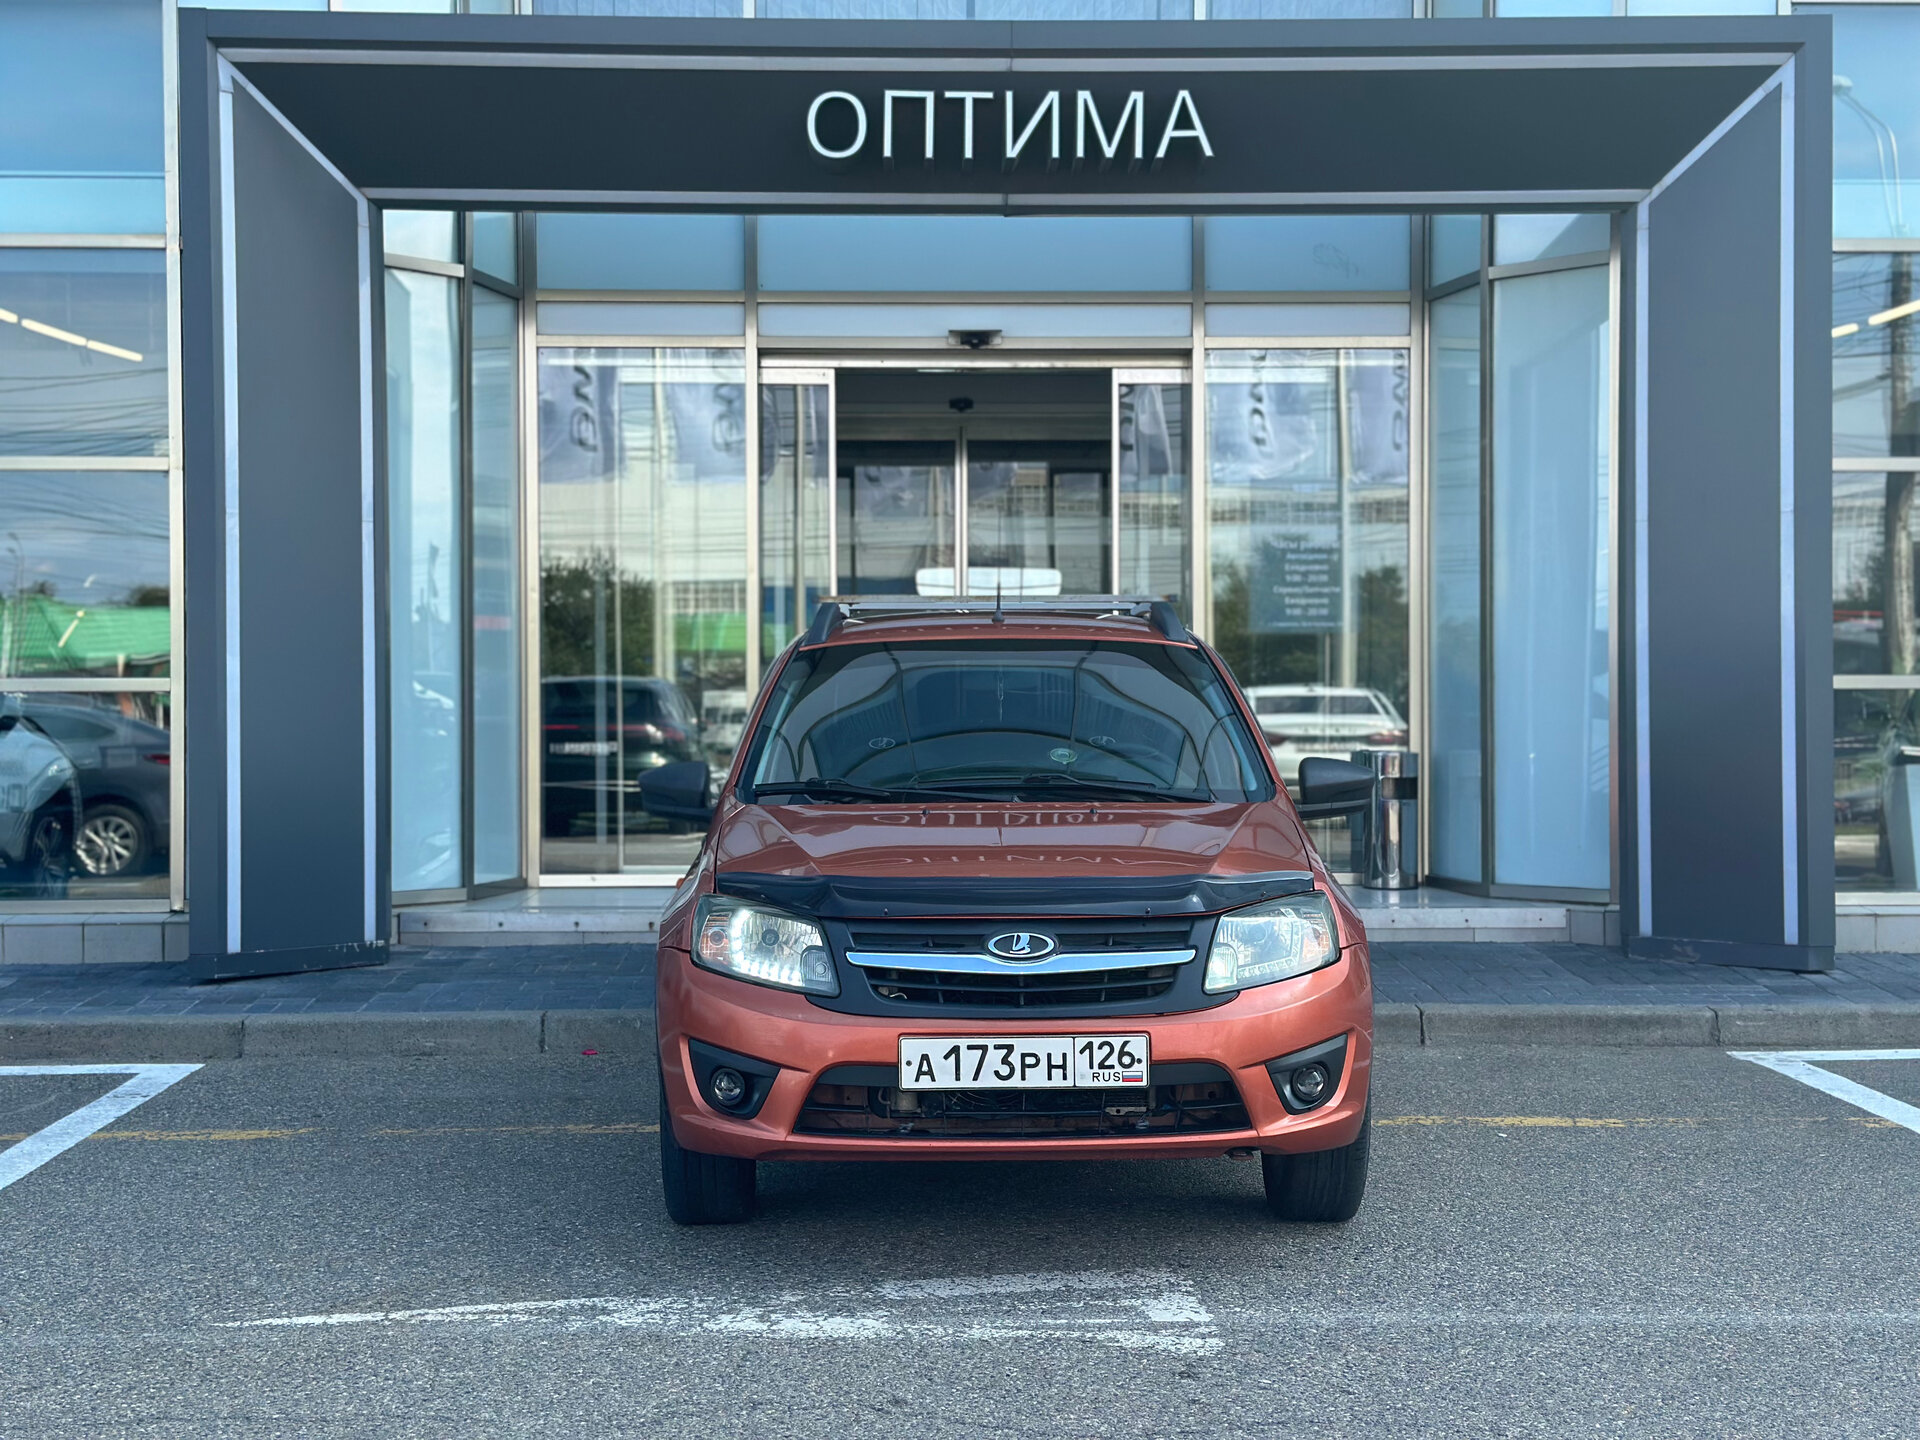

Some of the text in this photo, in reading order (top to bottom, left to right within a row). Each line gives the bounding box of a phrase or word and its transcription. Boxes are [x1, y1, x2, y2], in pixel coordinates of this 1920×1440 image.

[807, 89, 1215, 159] ОПТИМА
[1079, 1040, 1136, 1070] 126
[1092, 1071, 1121, 1082] RUS
